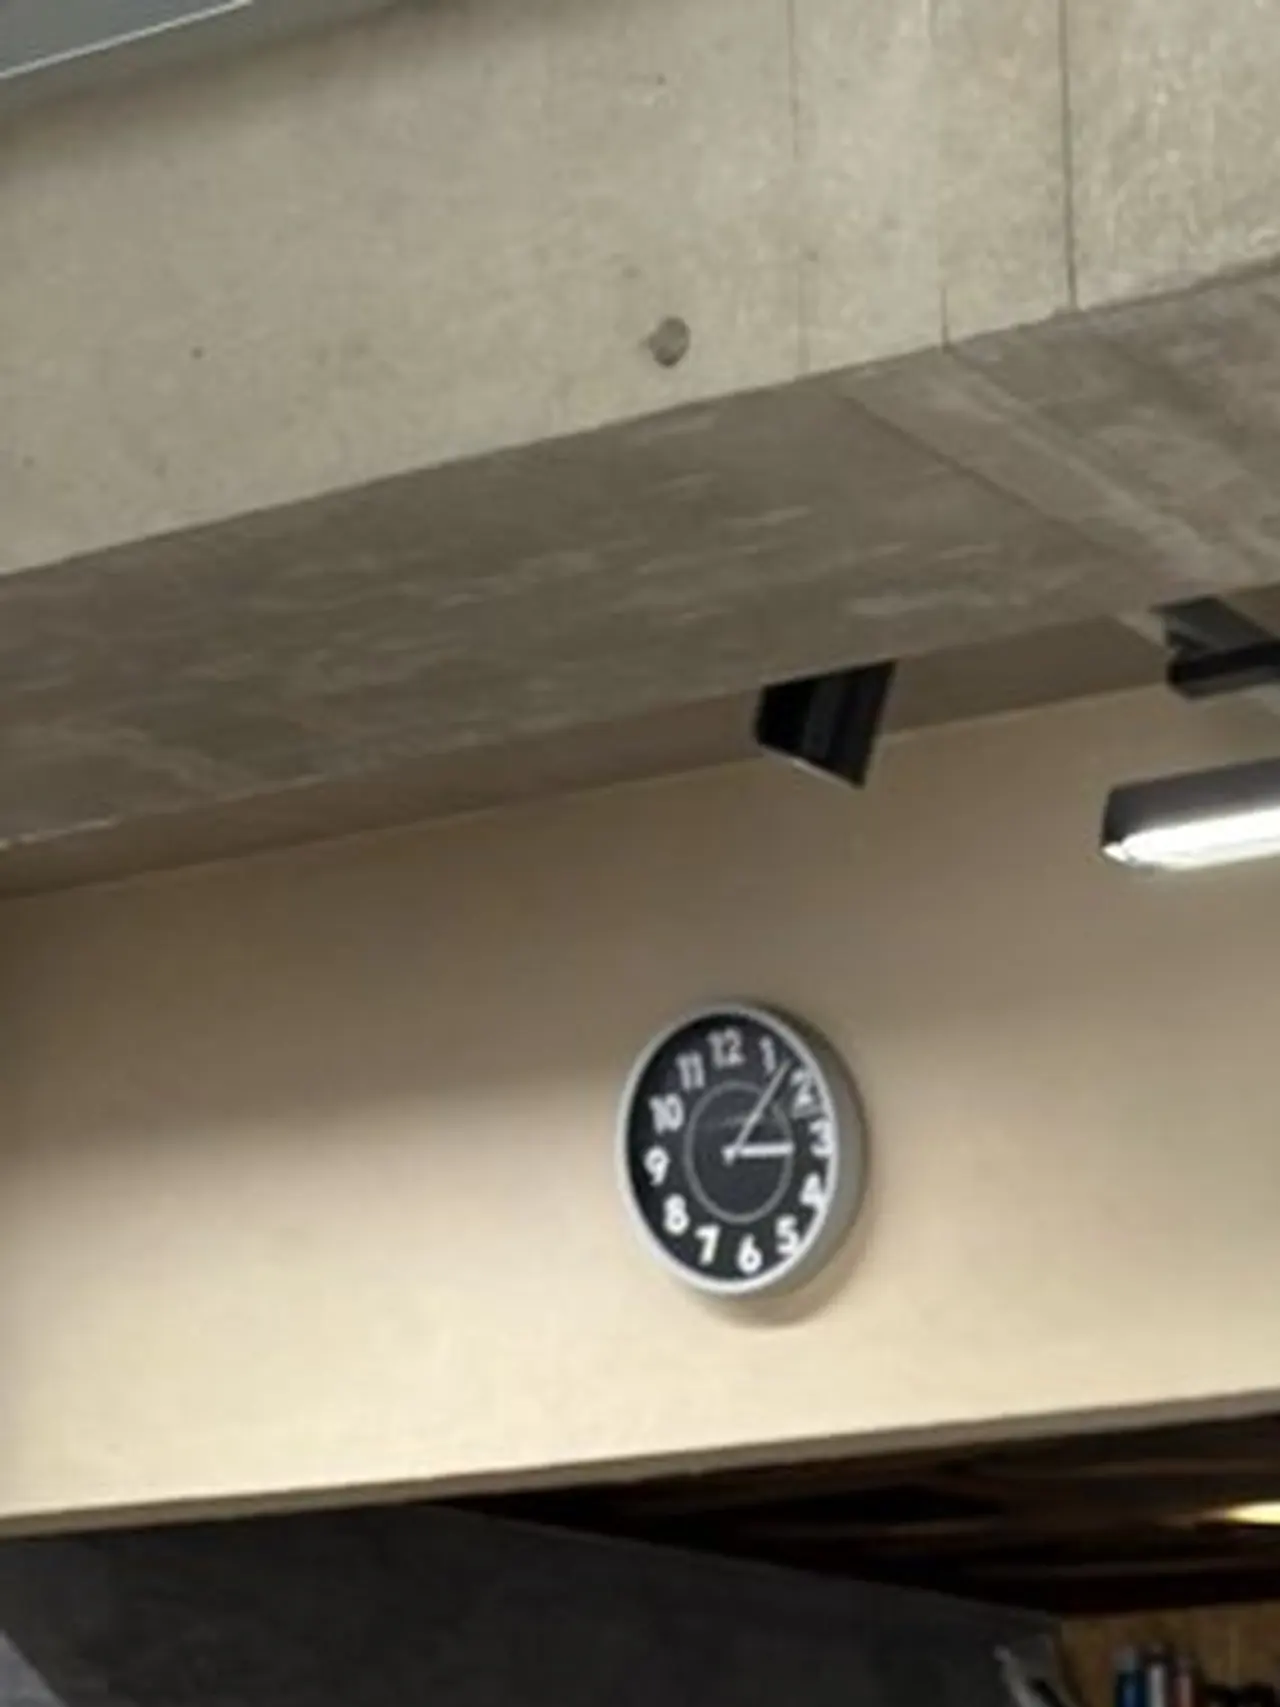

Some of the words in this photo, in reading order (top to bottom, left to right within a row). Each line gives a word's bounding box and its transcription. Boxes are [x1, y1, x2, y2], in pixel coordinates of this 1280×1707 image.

[706, 1026, 746, 1068] 12
[758, 1036, 776, 1074] 1
[676, 1051, 705, 1091] 11
[650, 1093, 684, 1134] 10
[790, 1068, 818, 1119] 2
[809, 1118, 834, 1158] 3
[643, 1146, 670, 1186] 9
[800, 1172, 828, 1211] 4
[664, 1193, 690, 1236] 8
[695, 1224, 720, 1266] 7
[737, 1234, 763, 1274] 6
[775, 1214, 800, 1257] 5
